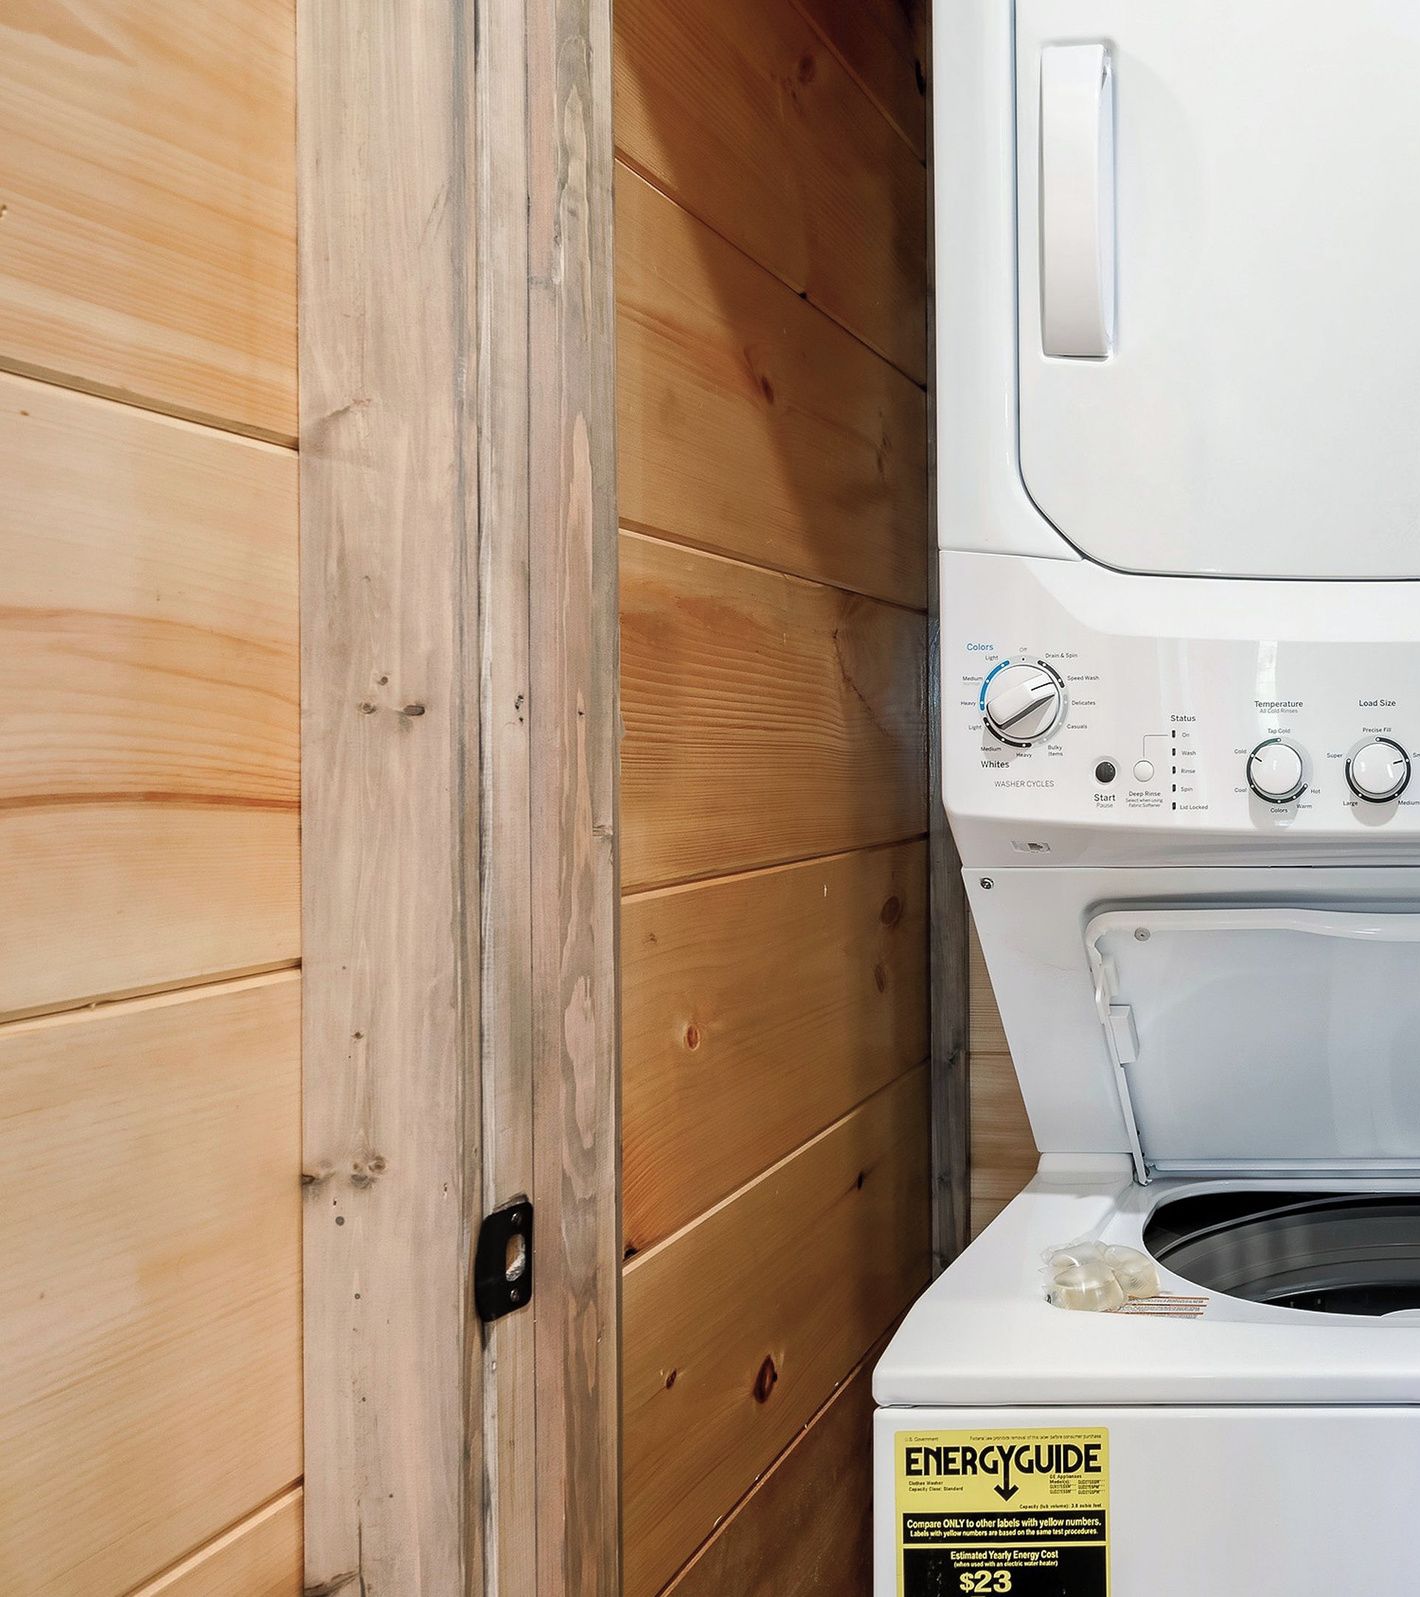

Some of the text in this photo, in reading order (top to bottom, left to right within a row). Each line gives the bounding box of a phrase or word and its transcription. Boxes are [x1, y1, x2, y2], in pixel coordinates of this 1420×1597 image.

[966, 643, 994, 651] Colors
[1254, 701, 1304, 709] Temperature
[980, 760, 1010, 769] Whites
[995, 780, 1055, 788] WASHER CYCLES
[905, 1444, 1101, 1476] ENERGYGUIDE
[907, 1517, 1102, 1530] Compare ONLY to other labels with yellow numbers.
[943, 1529, 961, 1538] yellow
[1064, 1528, 1098, 1536] procedures.
[950, 1550, 1059, 1561] Estimated Yearly Energy Cost
[959, 1570, 1012, 1593] $23
